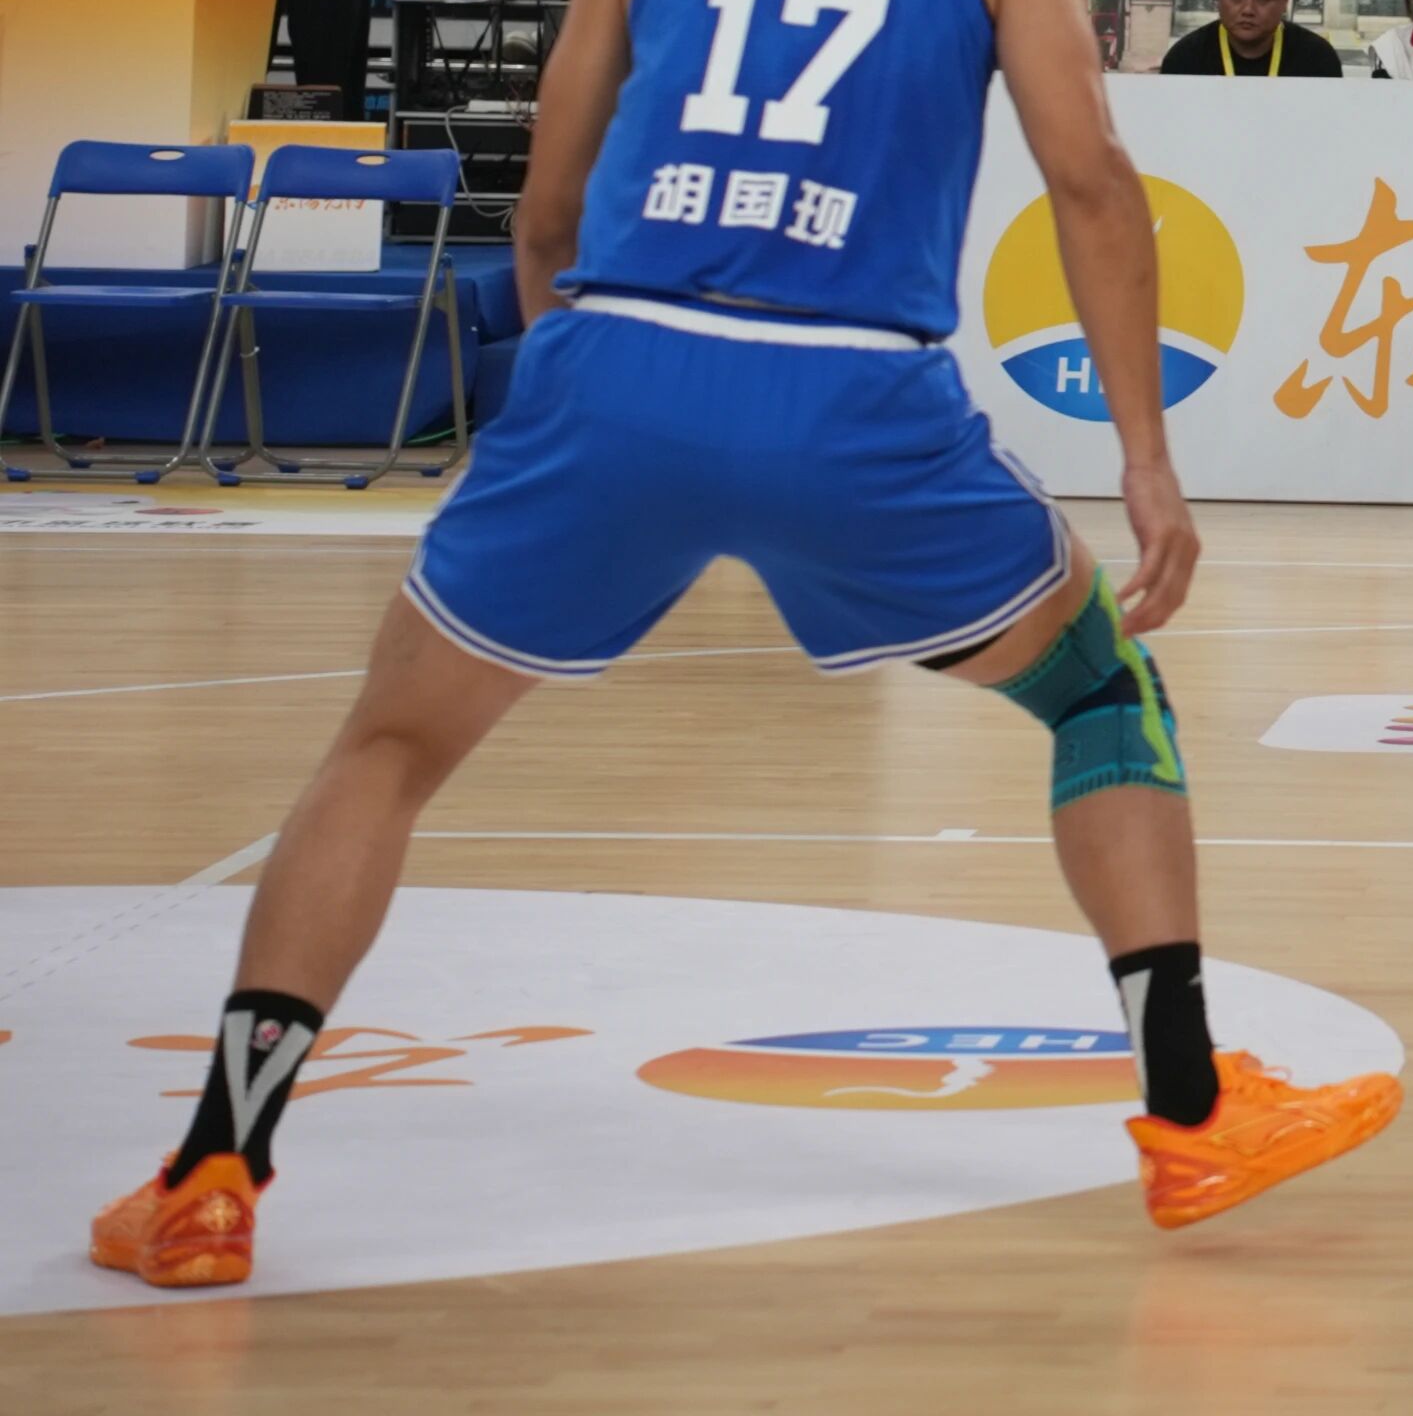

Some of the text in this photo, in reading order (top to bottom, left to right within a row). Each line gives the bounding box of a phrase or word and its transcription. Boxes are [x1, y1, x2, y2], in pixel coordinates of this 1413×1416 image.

[642, 162, 858, 250] 胡国现
[857, 1032, 1099, 1051] HEC
